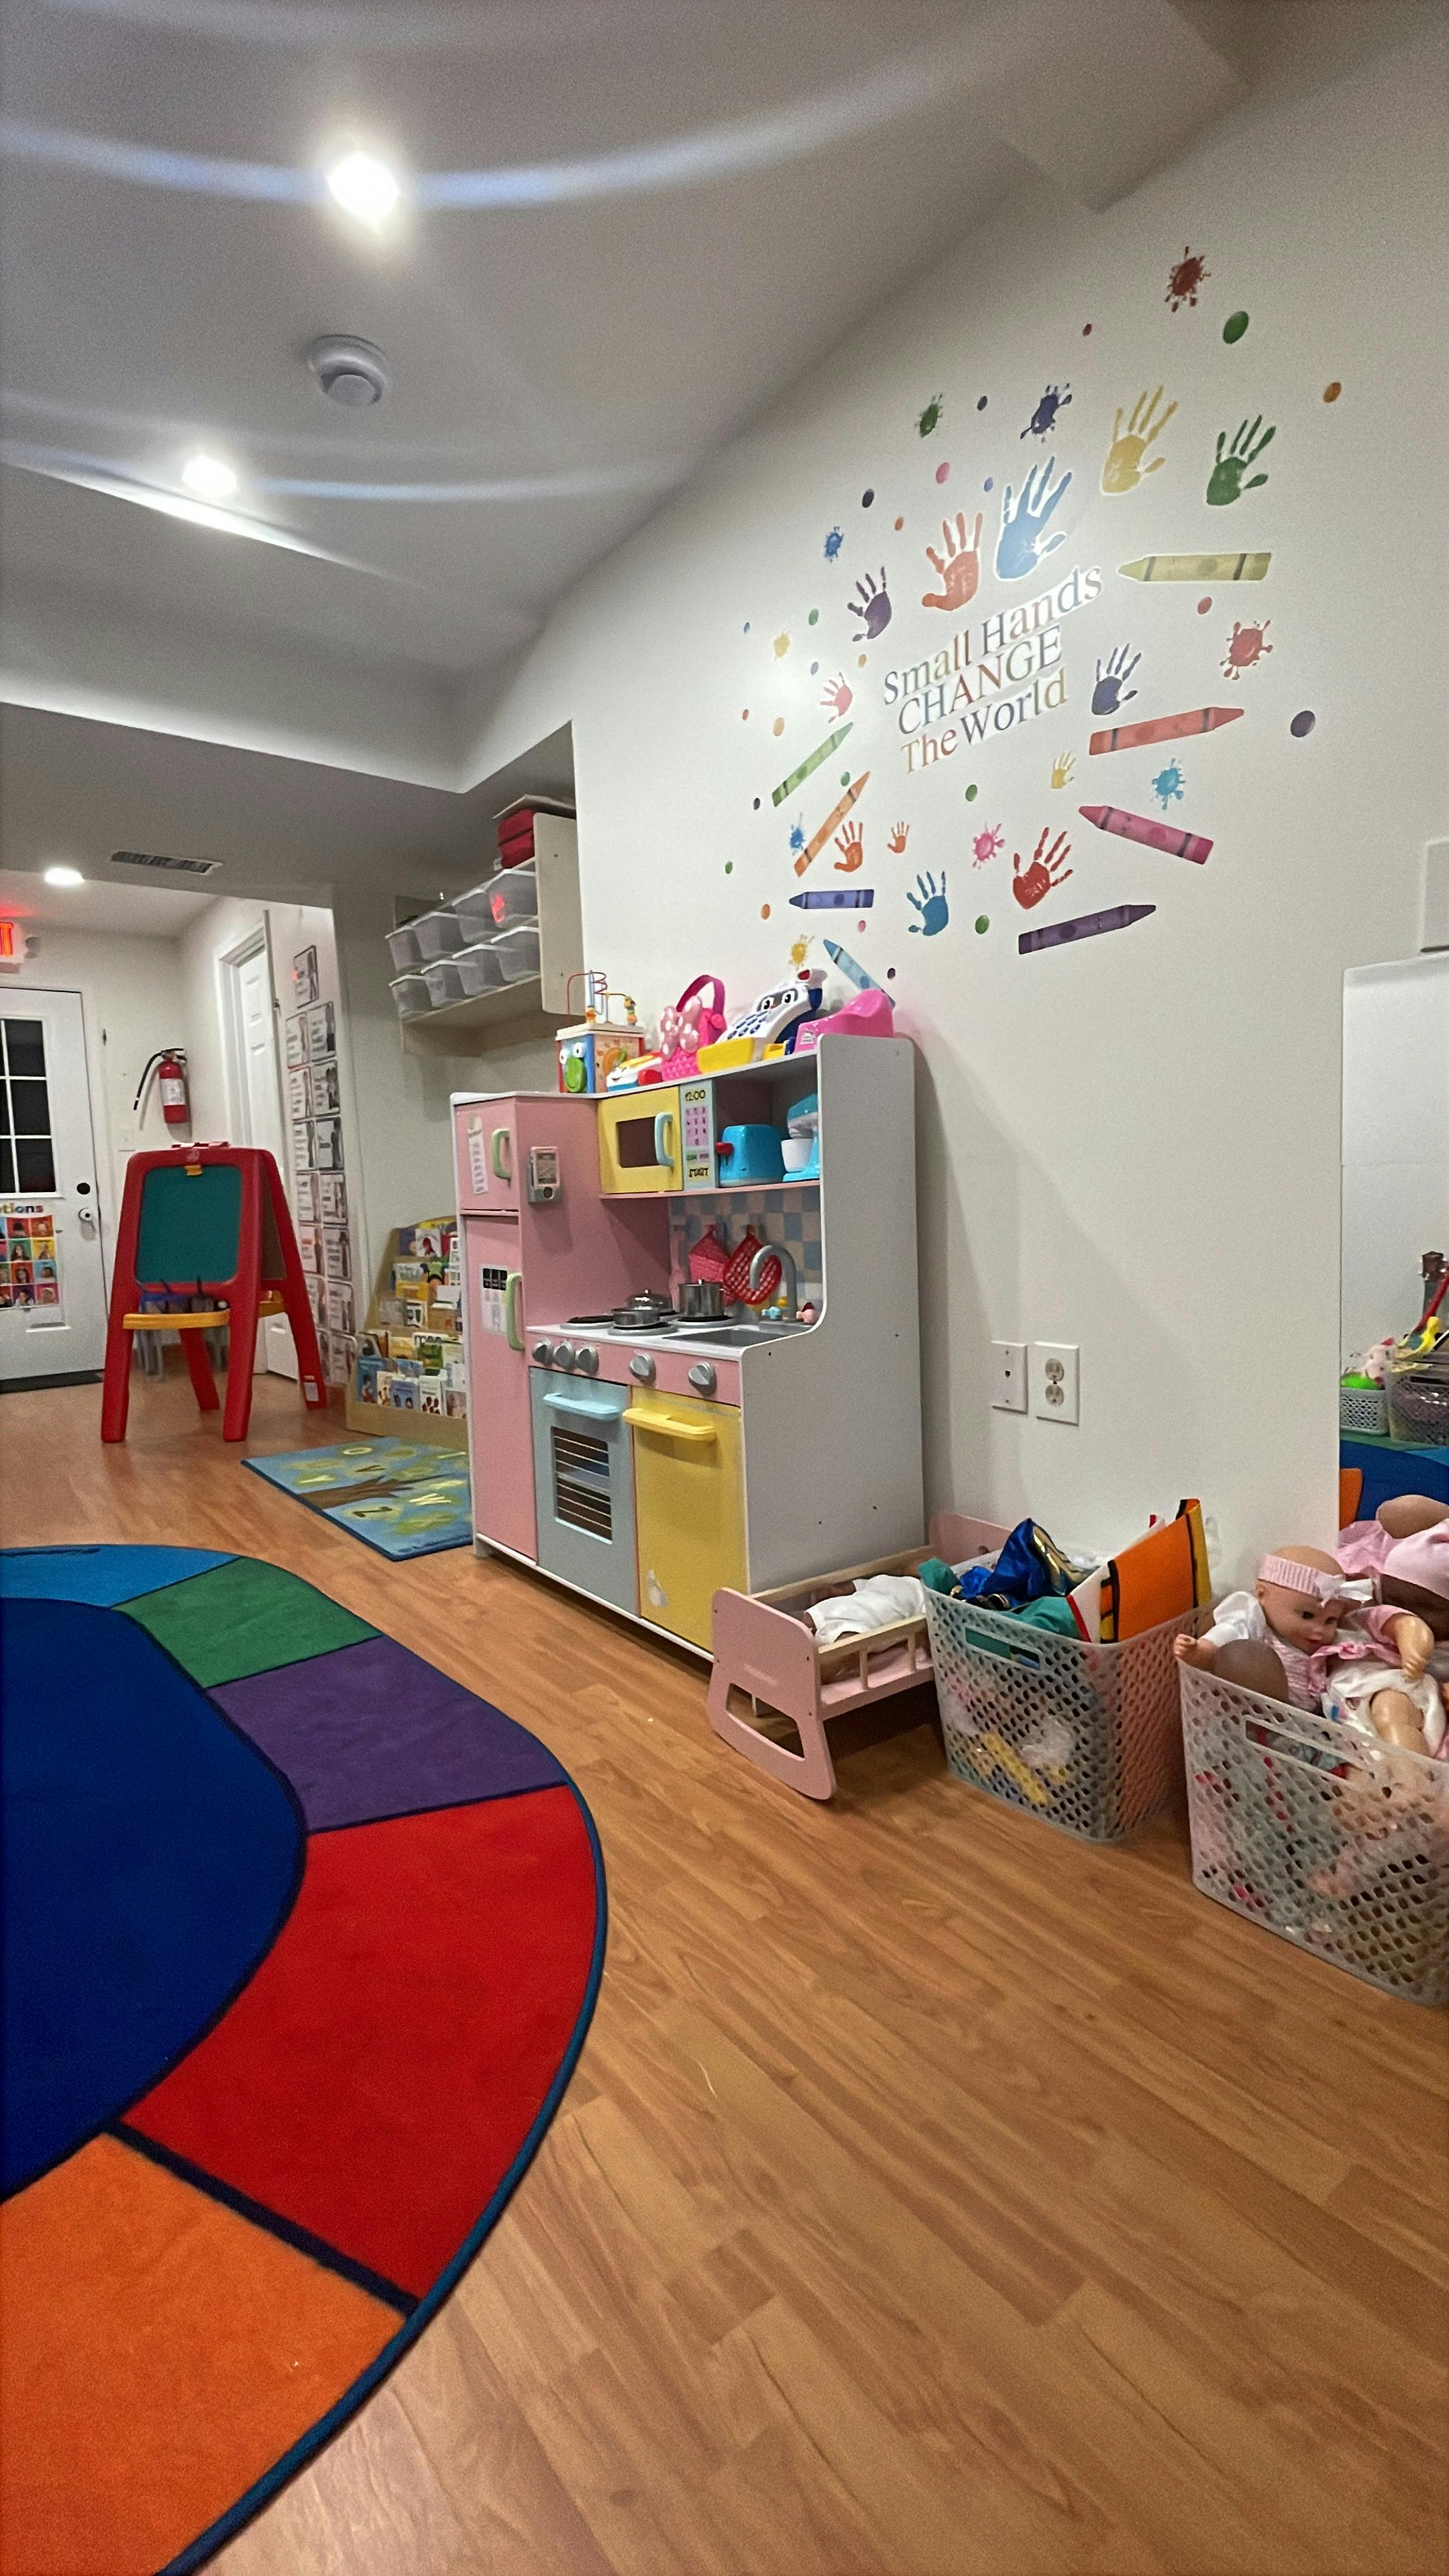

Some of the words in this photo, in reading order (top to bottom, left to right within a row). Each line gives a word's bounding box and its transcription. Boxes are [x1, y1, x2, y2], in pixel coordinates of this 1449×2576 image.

[884, 629, 971, 705] Small
[982, 566, 1102, 656] Hands
[898, 625, 1063, 735] CHANGE
[900, 729, 958, 773] The
[960, 666, 1068, 745] World
[0, 1202, 44, 1214] tions
